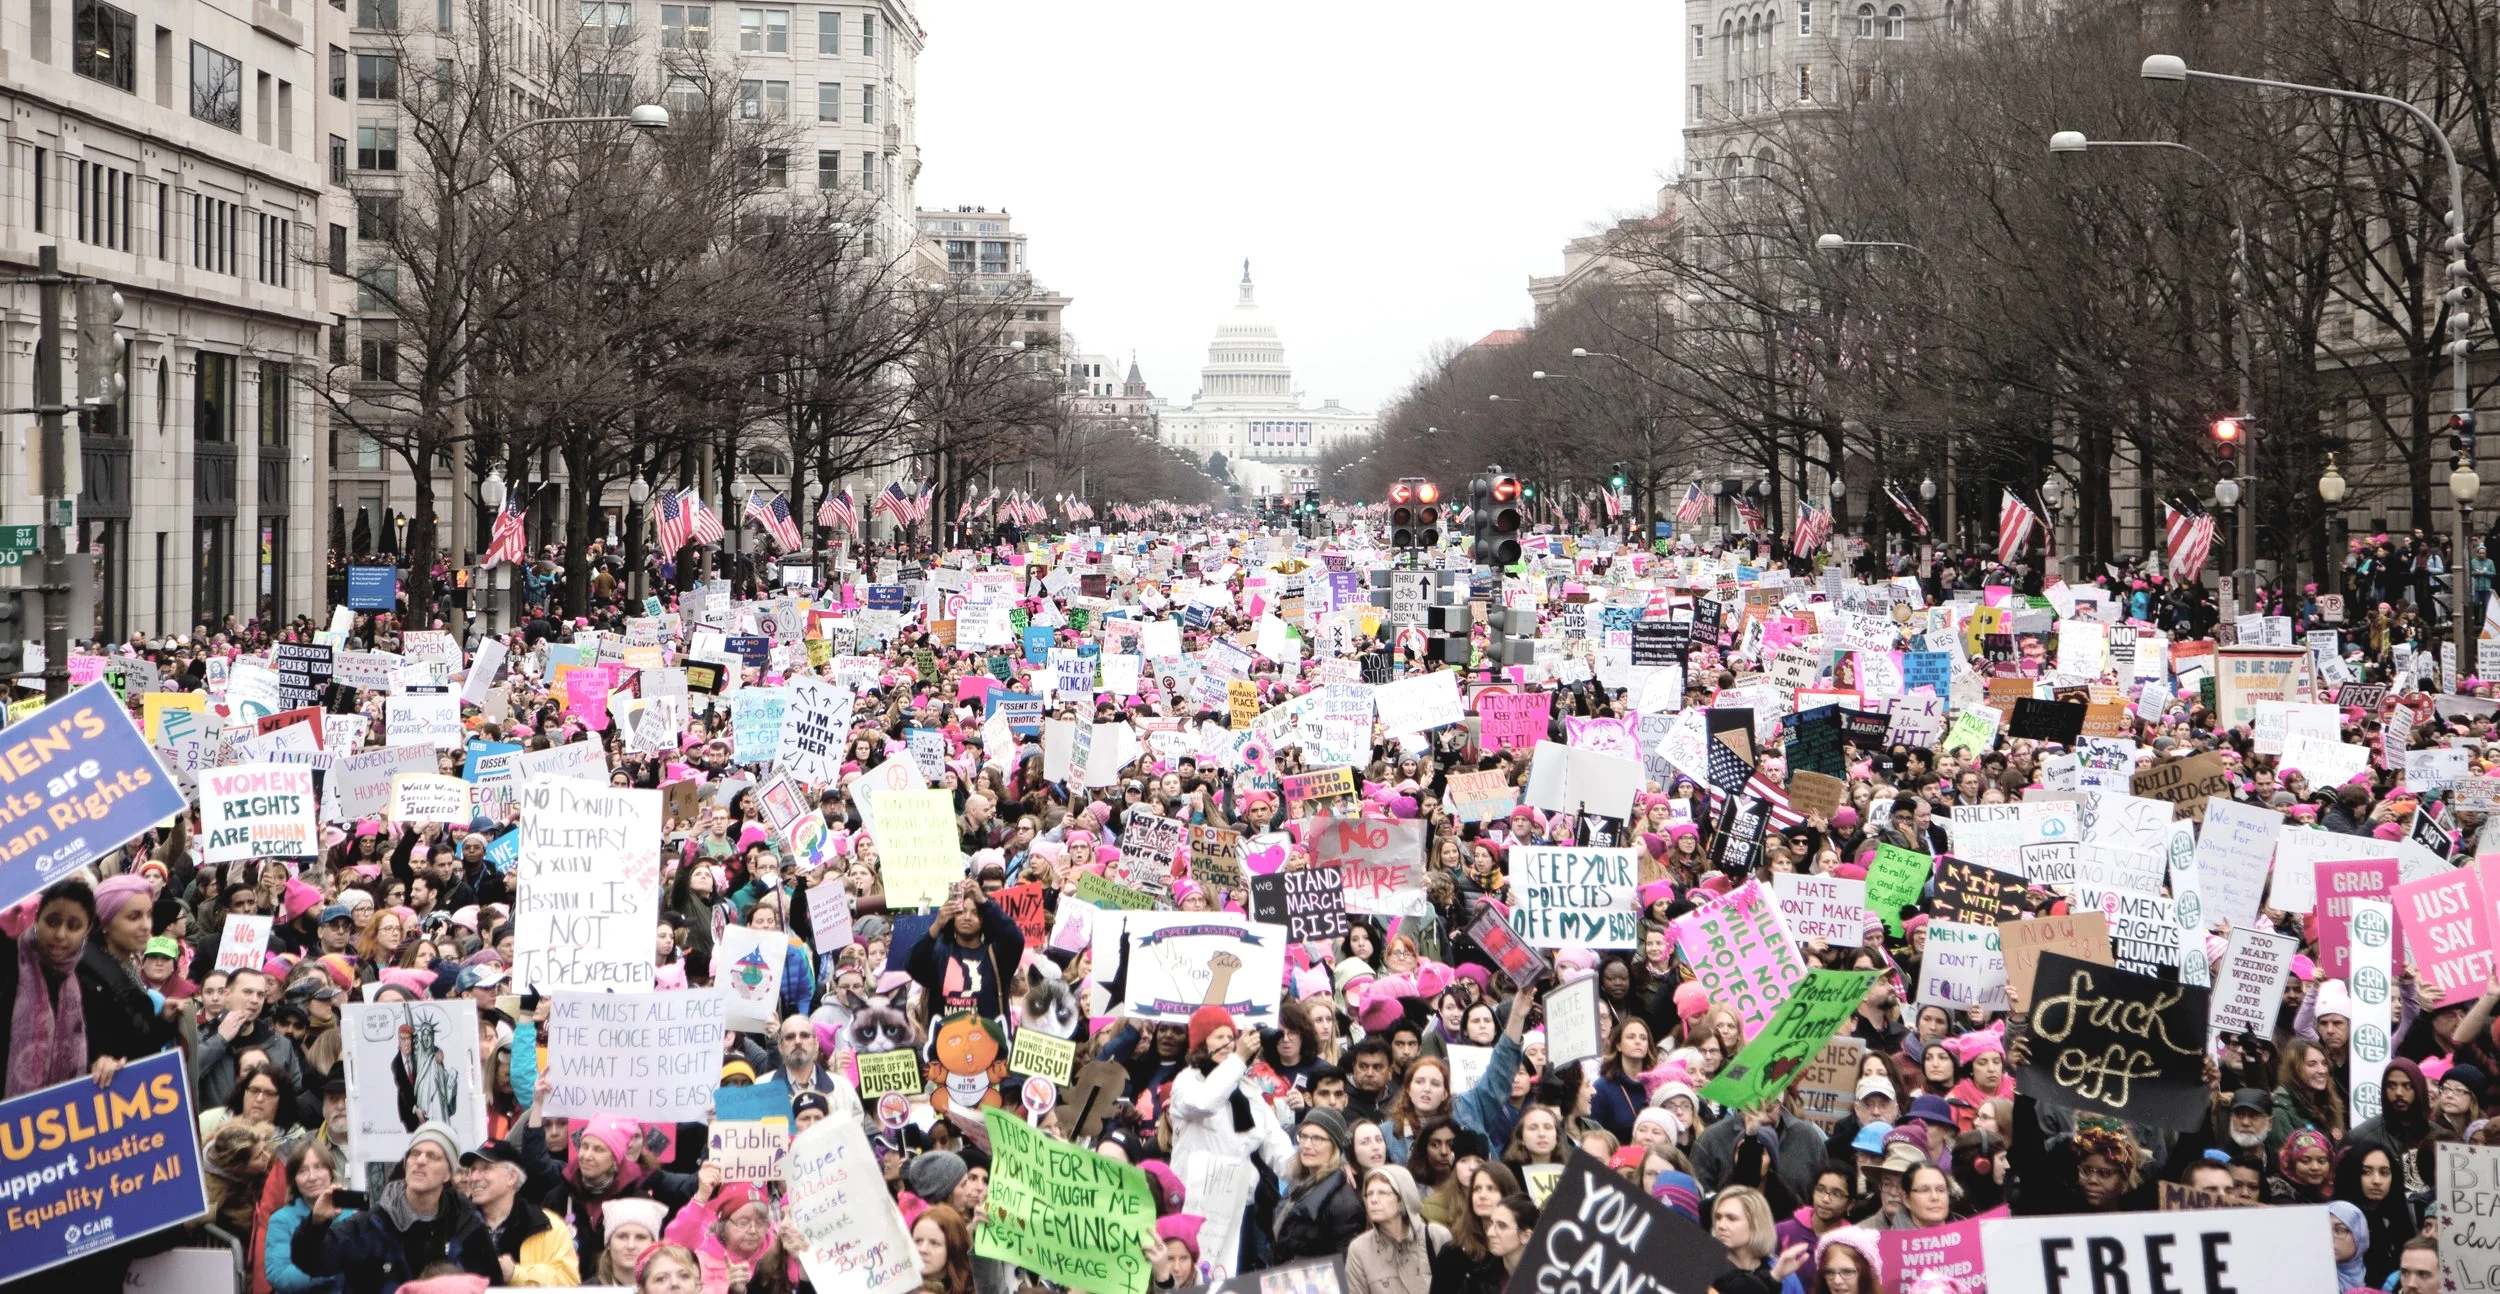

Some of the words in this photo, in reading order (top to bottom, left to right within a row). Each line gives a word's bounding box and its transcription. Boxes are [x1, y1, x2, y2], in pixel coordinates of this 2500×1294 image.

[16, 529, 31, 538] ST
[16, 538, 33, 546] NW
[1394, 574, 1415, 583] THRU
[1717, 590, 1740, 601] FIGHT
[1393, 602, 1415, 611] OBEY
[1416, 602, 1434, 611] THIS
[1564, 603, 1585, 614] BLACK
[1701, 609, 1716, 617] NOT
[1393, 612, 1421, 622] SIGNAL
[1564, 616, 1586, 628] LIVES
[1852, 614, 1891, 628] TRUMP
[1564, 629, 1586, 639] MATTER
[1693, 621, 1717, 633] OVARY
[1852, 622, 1860, 630] IS
[1862, 625, 1892, 636] GUILTY
[406, 632, 443, 642] NASTY
[1693, 629, 1717, 643] ACTION
[1846, 634, 1889, 652] TREASON
[1931, 634, 1954, 648] YES
[2111, 628, 2137, 645] NO!
[279, 646, 328, 658] NOBODY
[406, 644, 444, 653] WOMEN
[69, 658, 95, 668] SHE
[280, 660, 307, 671] PUTS
[312, 663, 331, 674] MY
[356, 658, 376, 666] UNITES
[378, 658, 387, 666] US
[1057, 660, 1085, 674] WE'RE
[1776, 651, 1819, 669] ABORTION
[280, 674, 308, 686] BABY
[1788, 667, 1800, 676] ON
[280, 688, 317, 699] MAKER
[1229, 690, 1256, 698] WOMAN'S
[1325, 684, 1338, 698] THE
[1338, 684, 1366, 696] POWER
[1233, 697, 1255, 707] PLACE
[1325, 701, 1337, 712] THE
[1338, 700, 1365, 712] PEOPLE
[393, 709, 415, 722] REAL
[436, 709, 453, 720] 140
[807, 710, 829, 727] I'M
[797, 721, 834, 744] WITH
[1850, 722, 1885, 733] MARCH
[797, 737, 826, 757] HER
[344, 752, 394, 772] WOMEN'S
[398, 744, 435, 763] RIGHTS
[919, 752, 938, 760] WITH
[921, 759, 936, 767] HER
[46, 759, 100, 798] are
[1295, 772, 1340, 787] UNITED
[2132, 765, 2183, 796] BUILD
[2409, 769, 2442, 780] SOCIAL
[212, 772, 311, 796] WOMEN'S
[1287, 789, 1304, 798] WE
[1311, 782, 1350, 796] STAND
[470, 786, 515, 804] EQUAL
[223, 795, 300, 821] RIGHTS
[1954, 805, 2020, 823] RACISM
[209, 827, 249, 848] ARE
[252, 823, 306, 841] HUMAN
[521, 814, 627, 851] MILITARY
[1732, 823, 1755, 835] LOVE
[2232, 830, 2251, 844] for
[252, 841, 303, 856] RIGHTS
[1727, 837, 1750, 852] NO
[1883, 850, 1903, 863] It's
[1905, 854, 1921, 869] fun
[1525, 853, 1578, 884] KEEP
[1580, 853, 1633, 887] YOUR
[1878, 864, 1889, 873] to
[1889, 867, 1911, 883] rally
[1255, 881, 1273, 891] we
[1284, 868, 1340, 894] STAND
[1968, 875, 2000, 897] I'M
[2333, 871, 2384, 893] GRAB
[1083, 882, 1119, 903] CANNOT
[1121, 898, 1147, 910] WAIT
[1089, 876, 1107, 888] OUR
[1111, 883, 1151, 904] CLIMATE
[1528, 884, 1612, 909] POLICIES
[1797, 882, 1838, 899] HATE
[1259, 906, 1276, 916] we
[1287, 892, 1345, 915] MARCH
[1961, 892, 2001, 914] WITH
[2412, 882, 2471, 923] JUST
[234, 924, 255, 943] We
[550, 915, 610, 949] NOT
[1291, 913, 1348, 939] RISE
[1799, 922, 1853, 940] GREAT!
[2251, 937, 2273, 948] TOO
[2429, 918, 2477, 954] SAY
[221, 949, 260, 968] won't
[2117, 938, 2180, 967] HUMAN
[2241, 947, 2279, 961] MANY
[1699, 919, 1765, 1024] PROTECT
[2234, 958, 2279, 974] THINGS
[2430, 950, 2494, 991] NYET
[1192, 970, 1210, 980] OR
[2232, 969, 2275, 986] WRONG
[2238, 983, 2261, 994] FOR
[945, 998, 977, 1006] WOMEN'S
[2235, 995, 2260, 1007] ONE
[552, 1002, 582, 1019] WE
[591, 1003, 640, 1022] MUST
[646, 1003, 675, 1022] ALL
[685, 998, 724, 1019] FACE
[2224, 1004, 2265, 1020] SMALL
[554, 1027, 588, 1046] THE
[598, 1028, 650, 1048] CHOICE
[658, 1023, 723, 1047] BETWEEN
[560, 1055, 618, 1078] WHAT
[630, 1056, 648, 1077] IS
[658, 1051, 711, 1076] RIGHT
[861, 1064, 886, 1074] HANDS
[887, 1062, 902, 1072] OFF
[904, 1061, 915, 1070] MY
[1014, 1050, 1068, 1080] PUSSY!
[863, 1072, 919, 1093] PUSSY!
[548, 1085, 587, 1106] AND
[592, 1088, 639, 1108] WHAT
[649, 1088, 667, 1108] IS
[675, 1083, 718, 1107] EASY
[0, 1074, 180, 1165] USLIMS
[725, 1128, 781, 1149] Public
[986, 1113, 1029, 1154] THIS
[1032, 1135, 1044, 1167] IS
[1049, 1150, 1089, 1183] FOR
[1093, 1159, 1124, 1190] MY
[792, 1146, 844, 1181] Super
[7, 1186, 104, 1231] Equality
[110, 1173, 144, 1197] for
[152, 1154, 182, 1185] All
[990, 1180, 1026, 1211] ABOUT
[1030, 1197, 1142, 1255] FEMINISM
[1578, 1170, 1652, 1254] YOU
[83, 1216, 114, 1236] CAIR
[1902, 1239, 1907, 1251] I
[1911, 1232, 1961, 1248] STAND
[1902, 1251, 1945, 1266] WITH
[2039, 1230, 2238, 1294] FREE
